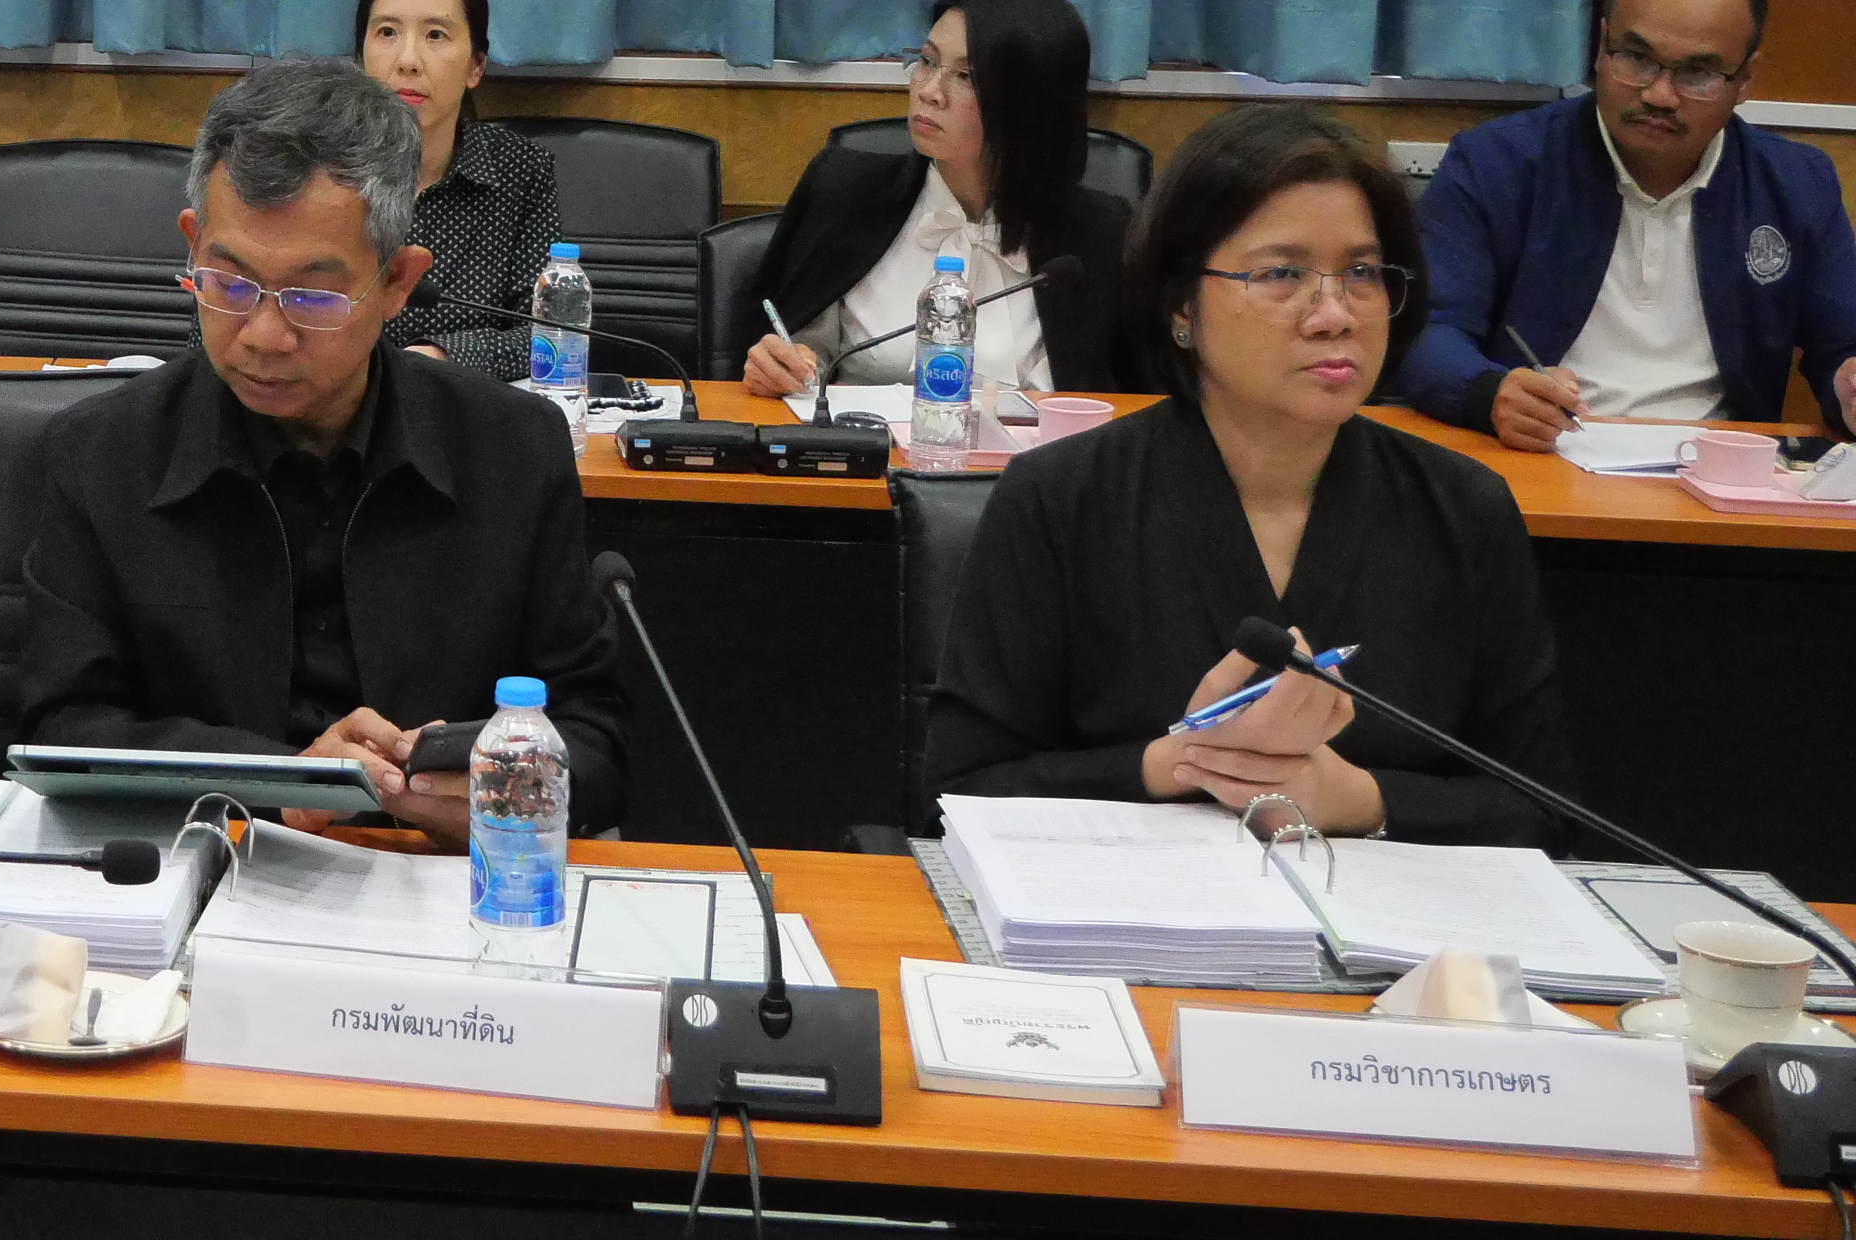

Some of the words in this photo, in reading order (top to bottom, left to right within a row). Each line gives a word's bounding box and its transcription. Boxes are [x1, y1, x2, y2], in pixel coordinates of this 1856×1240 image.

[331, 1003, 514, 1045] กรมพัฒนาที่ดิน
[1311, 1054, 1551, 1094] กรมวิชาการเกษตร
